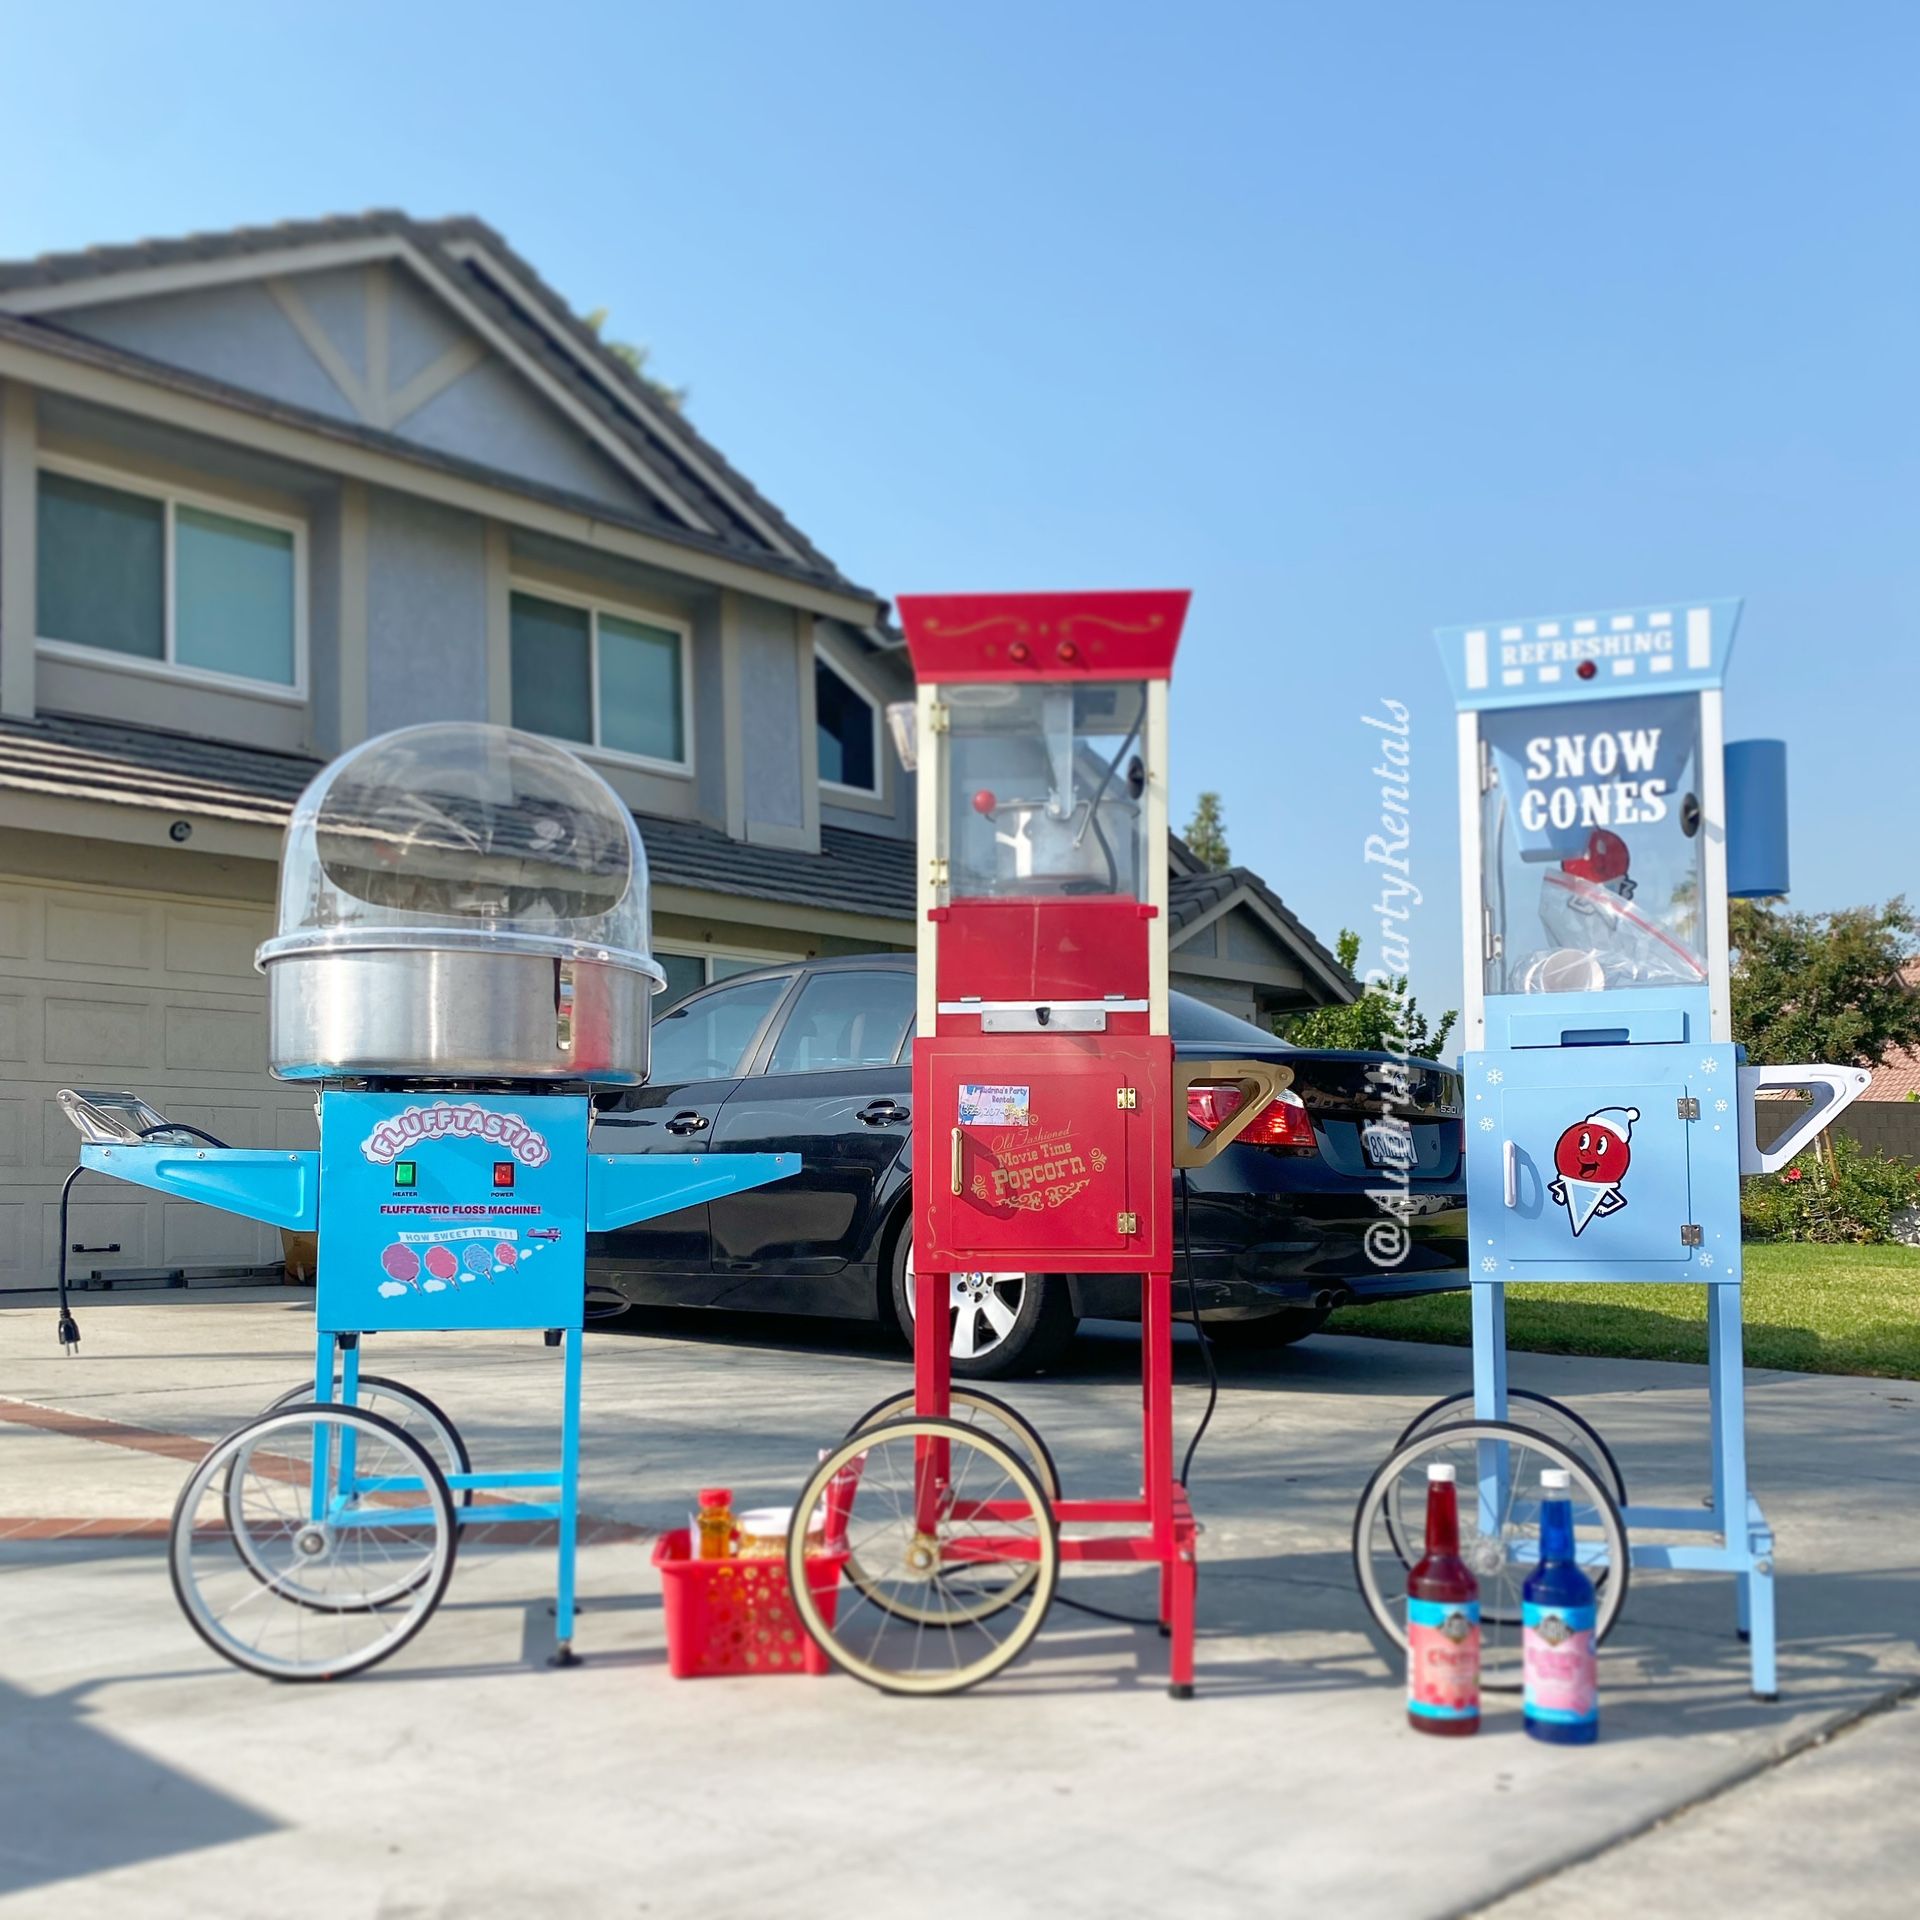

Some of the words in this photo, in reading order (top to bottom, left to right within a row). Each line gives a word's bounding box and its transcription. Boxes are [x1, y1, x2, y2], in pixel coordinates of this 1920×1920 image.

[1502, 630, 1673, 666] REFRESHING
[1525, 729, 1662, 781] SNOW
[1519, 779, 1669, 832] CONES
[371, 1108, 544, 1162] FLUFFTASTIC
[991, 1133, 1015, 1152] Old
[1017, 1119, 1072, 1147] Fashioned
[996, 1148, 1039, 1168] Movie
[1040, 1142, 1073, 1158] Time
[991, 1156, 1086, 1195] Popcorn
[380, 1205, 451, 1214] FLUFFTASTIC
[452, 1205, 486, 1214] FLOSS
[488, 1205, 542, 1215] MACHINE!
[405, 1233, 430, 1242] HOW
[434, 1230, 468, 1241] SWEET
[473, 1228, 482, 1236] IT
